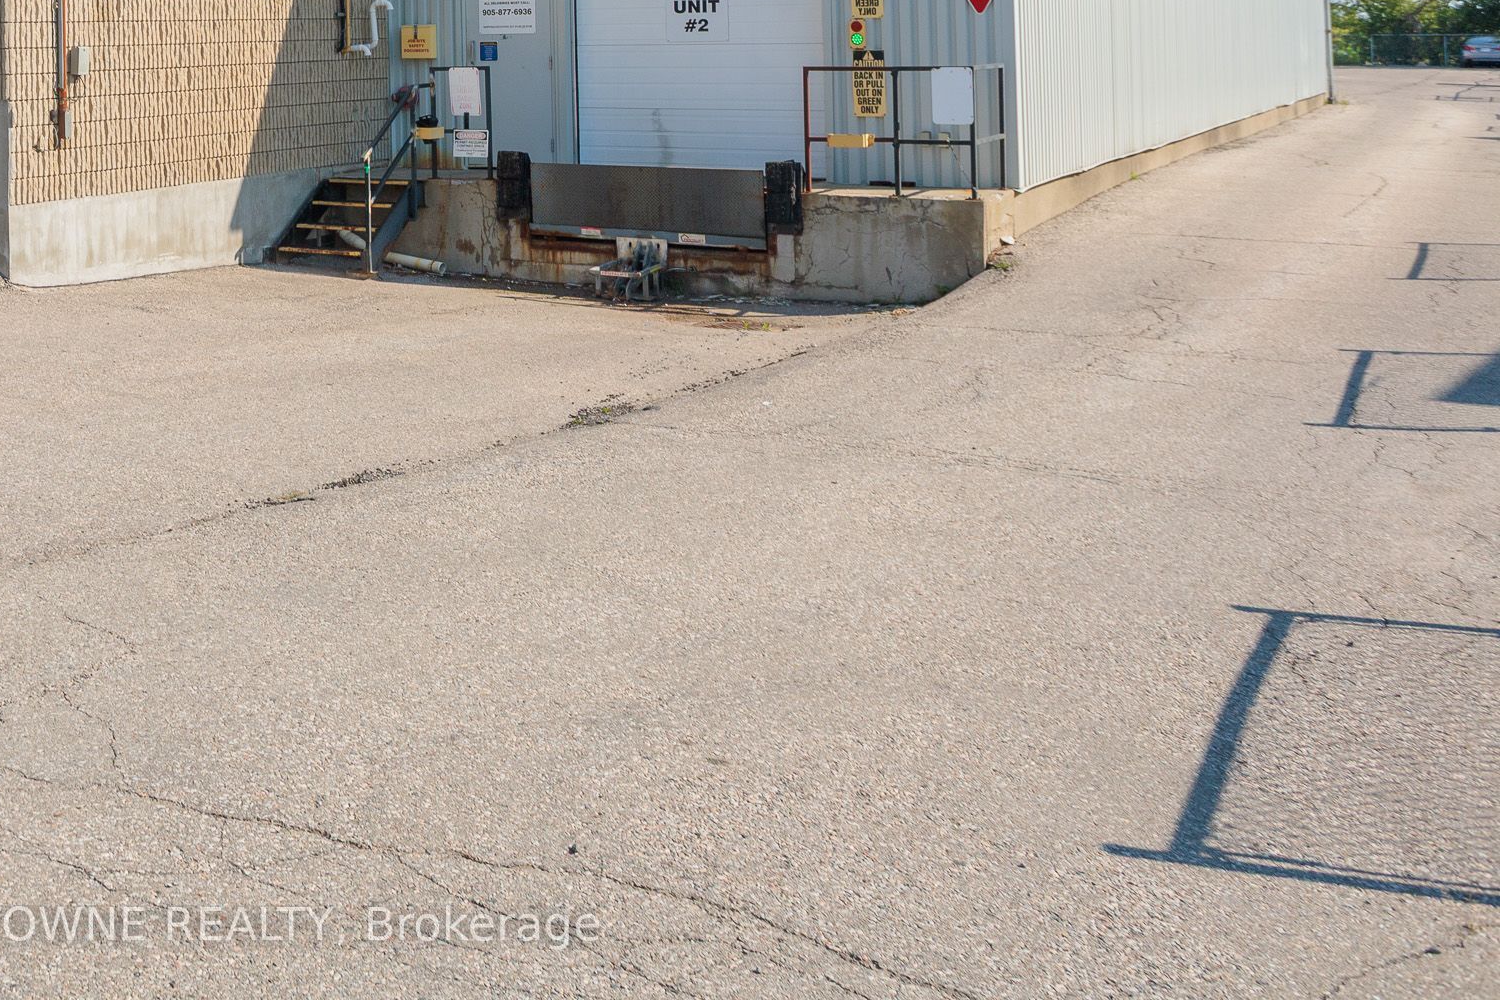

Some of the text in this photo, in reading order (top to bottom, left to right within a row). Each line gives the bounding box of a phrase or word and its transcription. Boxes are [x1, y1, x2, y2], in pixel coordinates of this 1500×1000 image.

[673, 0, 720, 14] UNIT
[482, 8, 532, 16] 905-877-6936
[684, 18, 709, 32] #2
[853, 59, 884, 67] CAUTION
[854, 80, 884, 88] OR PULL
[857, 97, 881, 105] GREEN
[861, 105, 879, 113] ONLY
